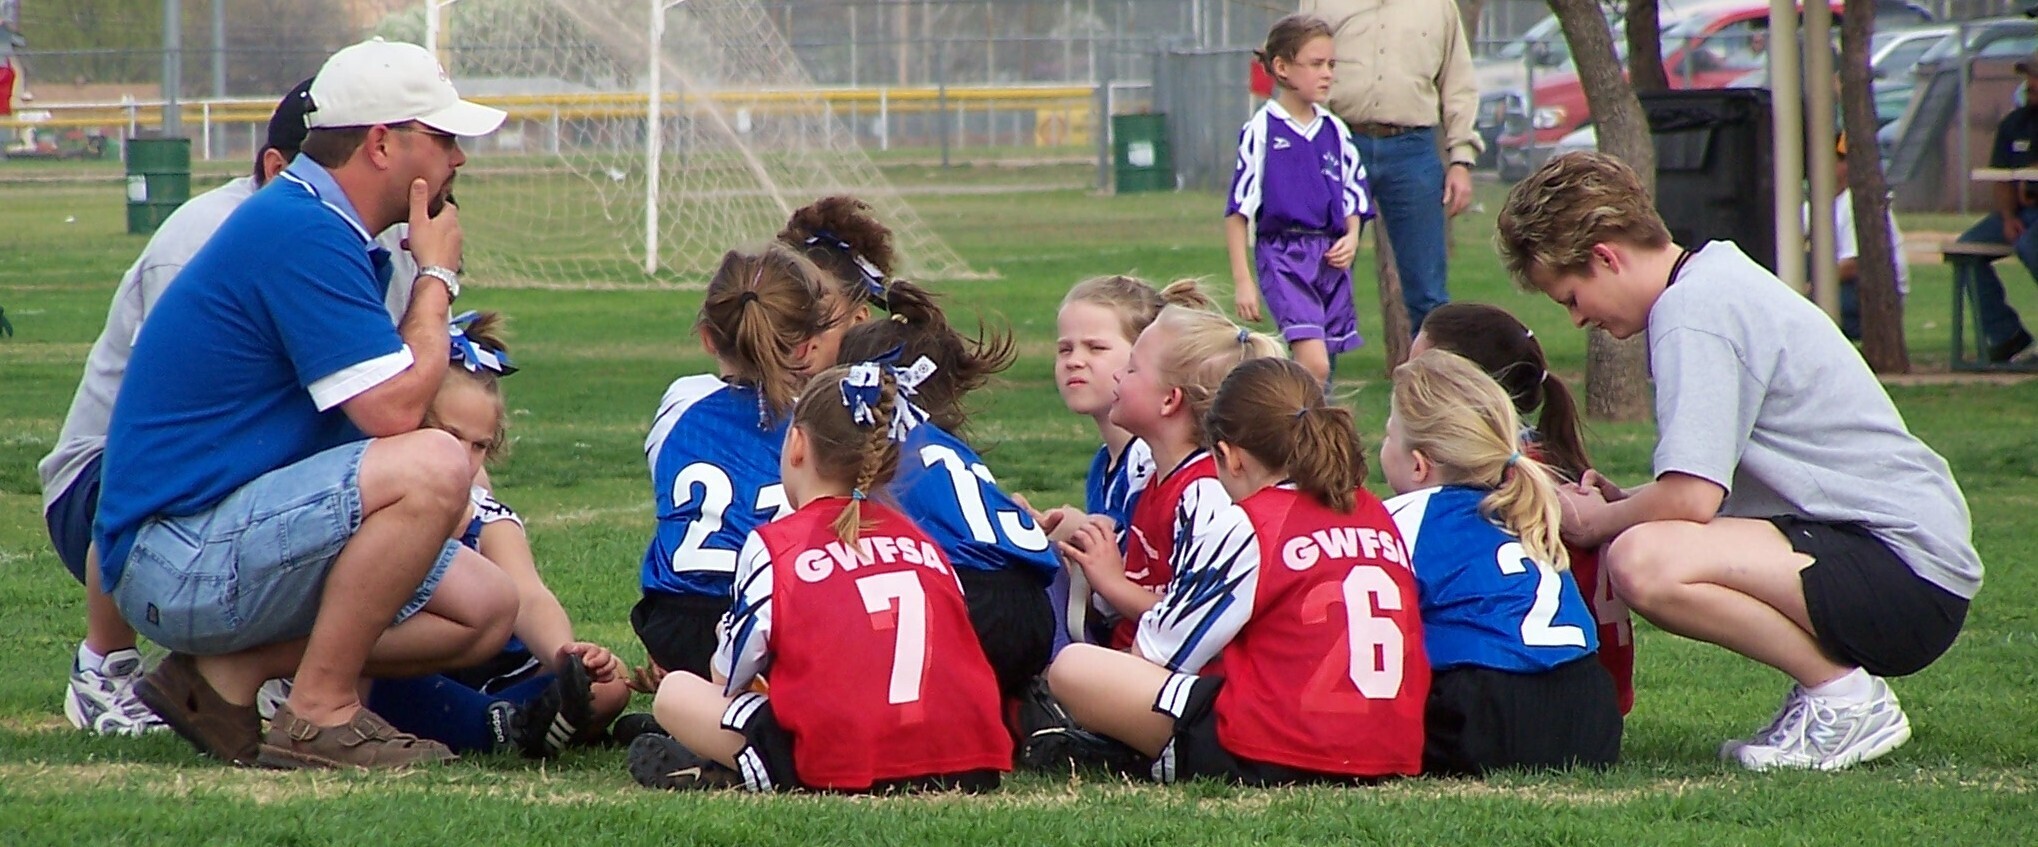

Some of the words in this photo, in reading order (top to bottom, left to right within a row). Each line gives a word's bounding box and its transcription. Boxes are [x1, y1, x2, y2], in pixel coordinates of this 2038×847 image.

[794, 536, 950, 583] GWFSA
[1497, 542, 1587, 648] 2
[855, 570, 926, 705] 7
[1342, 565, 1405, 699] 6
